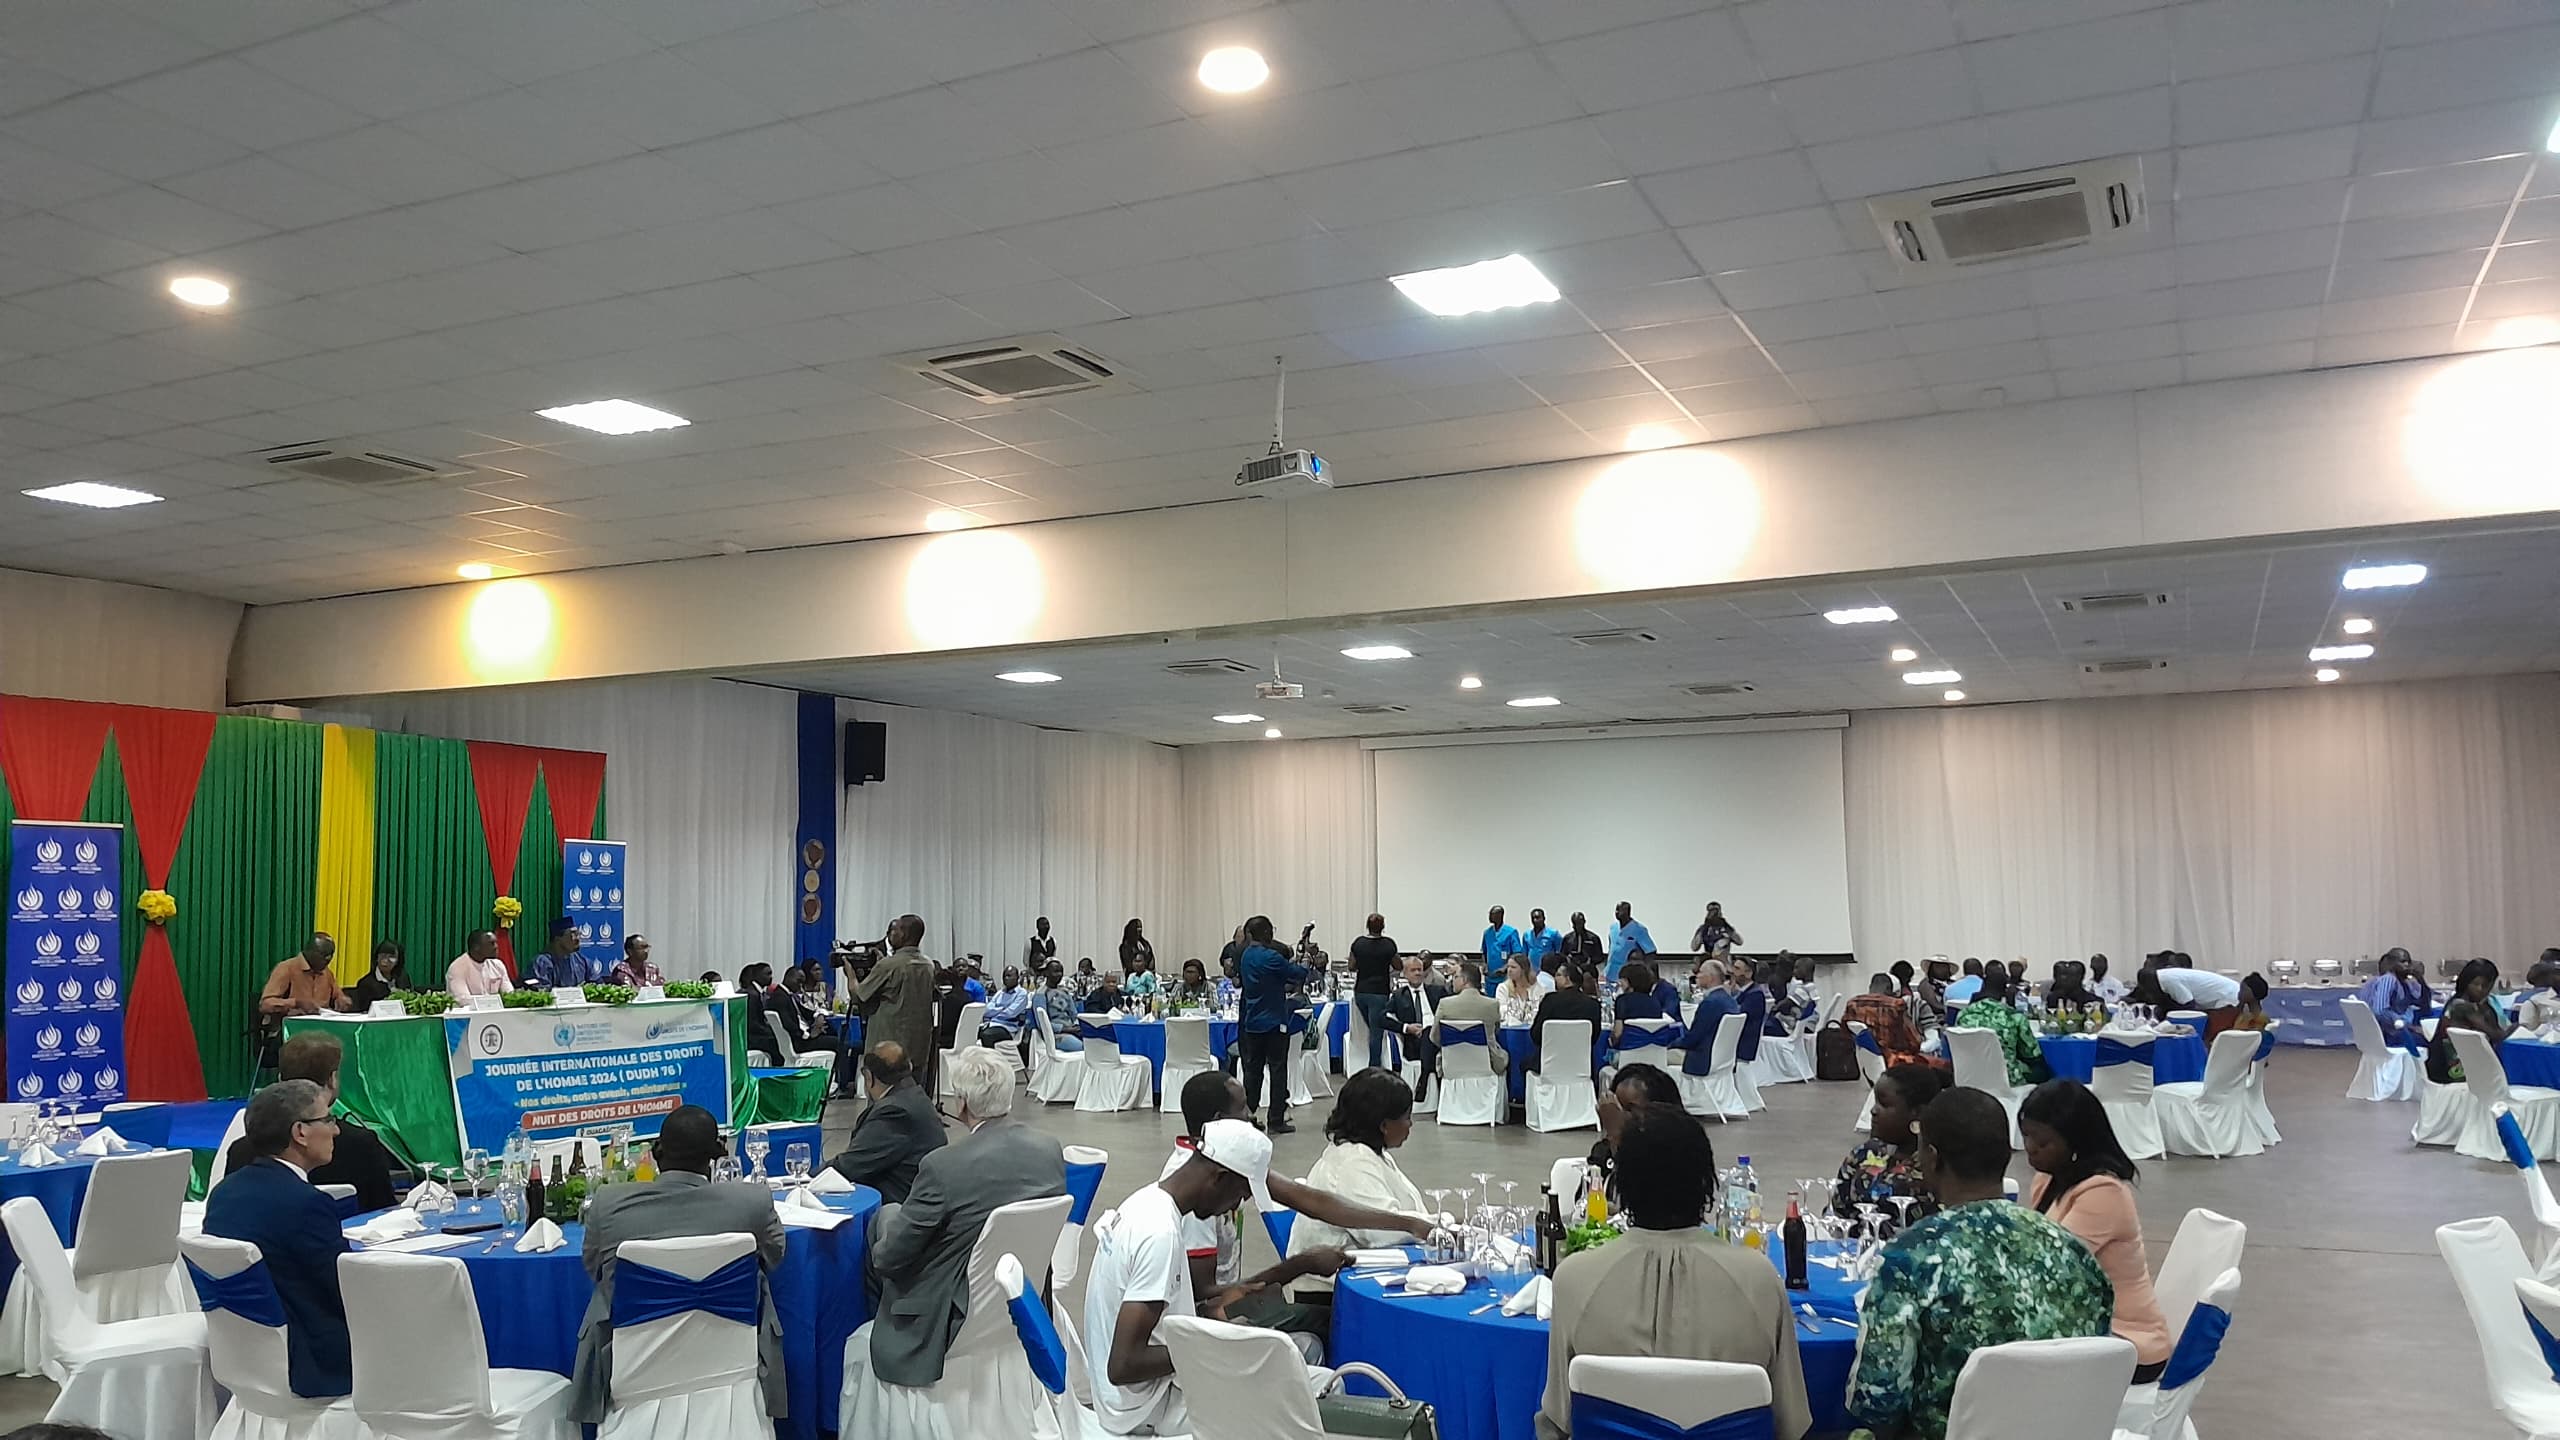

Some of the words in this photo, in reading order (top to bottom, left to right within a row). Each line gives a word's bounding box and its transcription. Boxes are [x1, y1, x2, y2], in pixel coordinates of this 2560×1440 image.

[485, 1059, 540, 1077] JOURNÉE
[541, 1053, 638, 1073] INTERNATIONALE
[640, 1050, 662, 1064] DES
[664, 1046, 704, 1062] DROITS
[516, 1079, 533, 1092] DE
[535, 1074, 588, 1090] L'HOMME
[590, 1071, 617, 1085] 2024
[626, 1067, 659, 1081] DUDH
[661, 1065, 676, 1077] 76
[532, 1114, 557, 1126] NUIT
[558, 1111, 578, 1123] DES
[581, 1106, 616, 1121] DROITS
[617, 1104, 631, 1116] DE
[633, 1099, 673, 1112] L'HOMME
